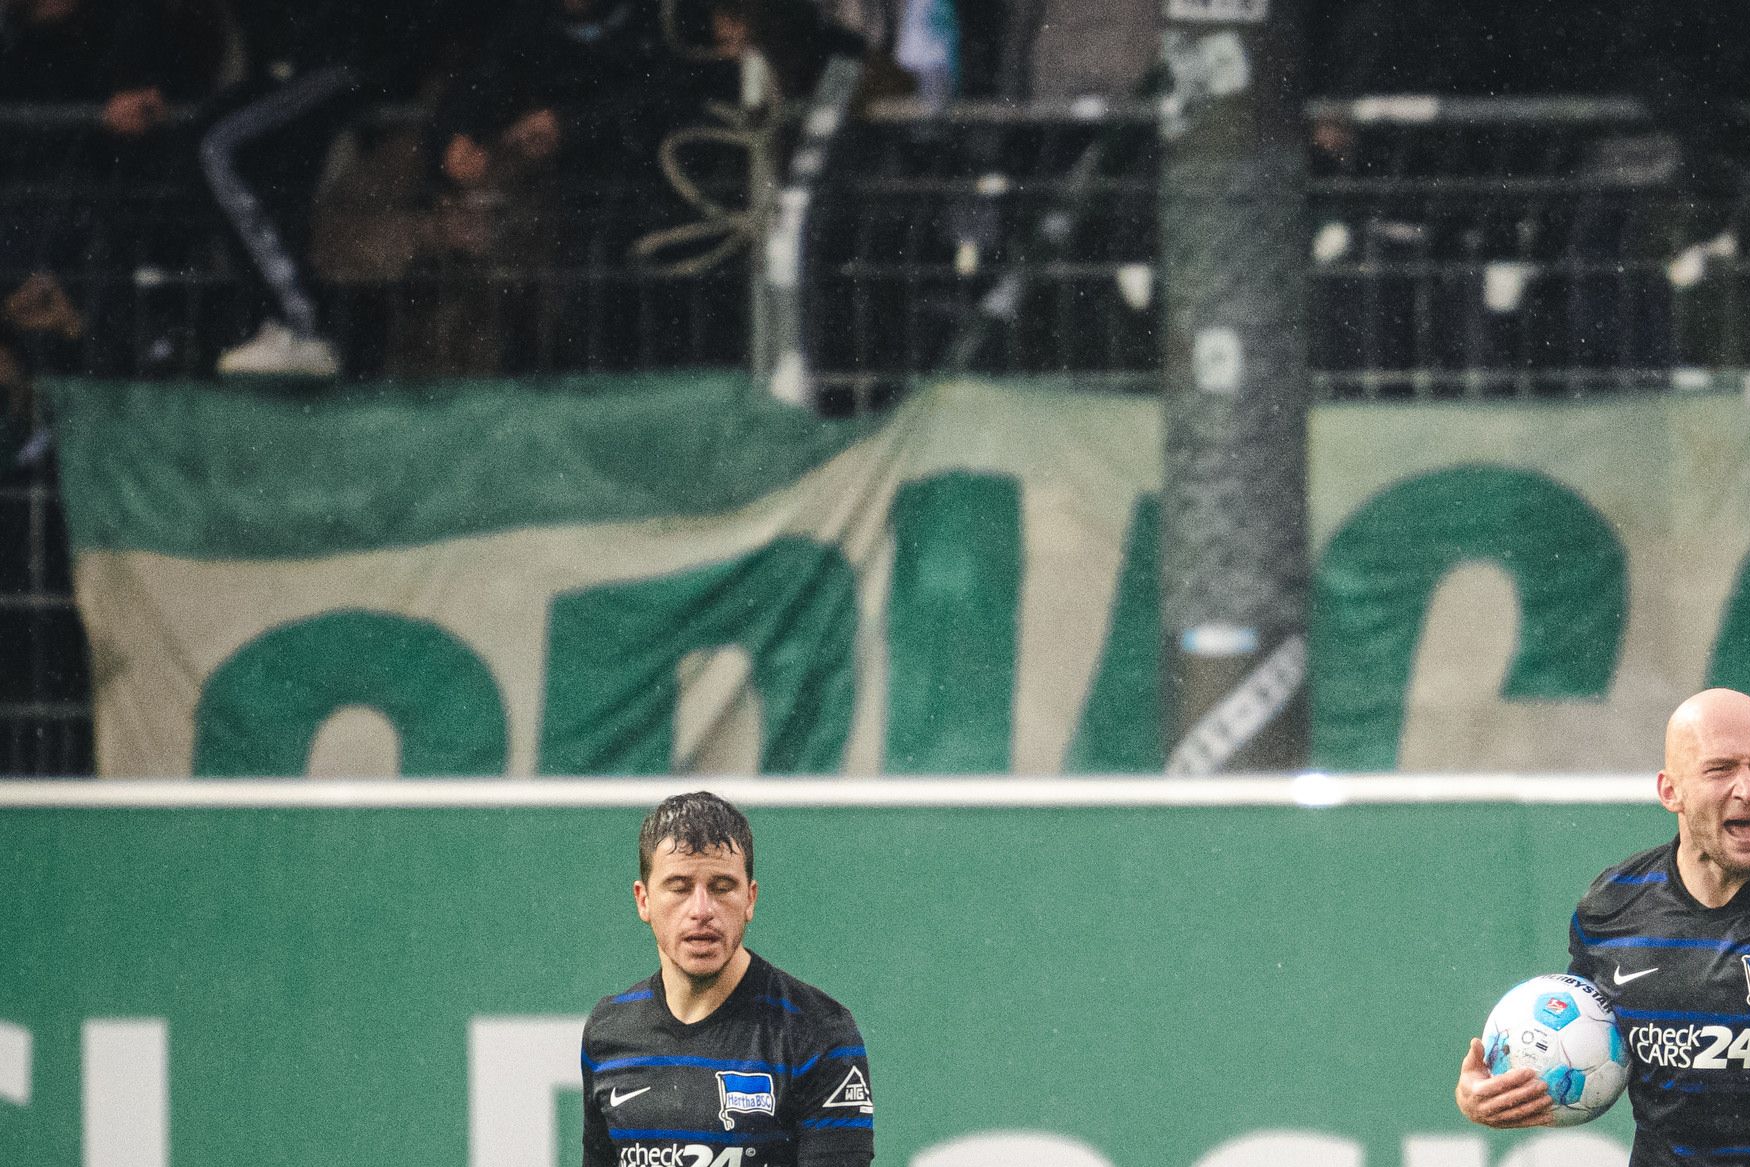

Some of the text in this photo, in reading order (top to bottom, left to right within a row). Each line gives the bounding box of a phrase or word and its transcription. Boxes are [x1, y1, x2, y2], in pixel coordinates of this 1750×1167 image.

[1638, 1023, 1701, 1047] check
[1637, 1042, 1692, 1068] CARS
[628, 1143, 684, 1166] check
